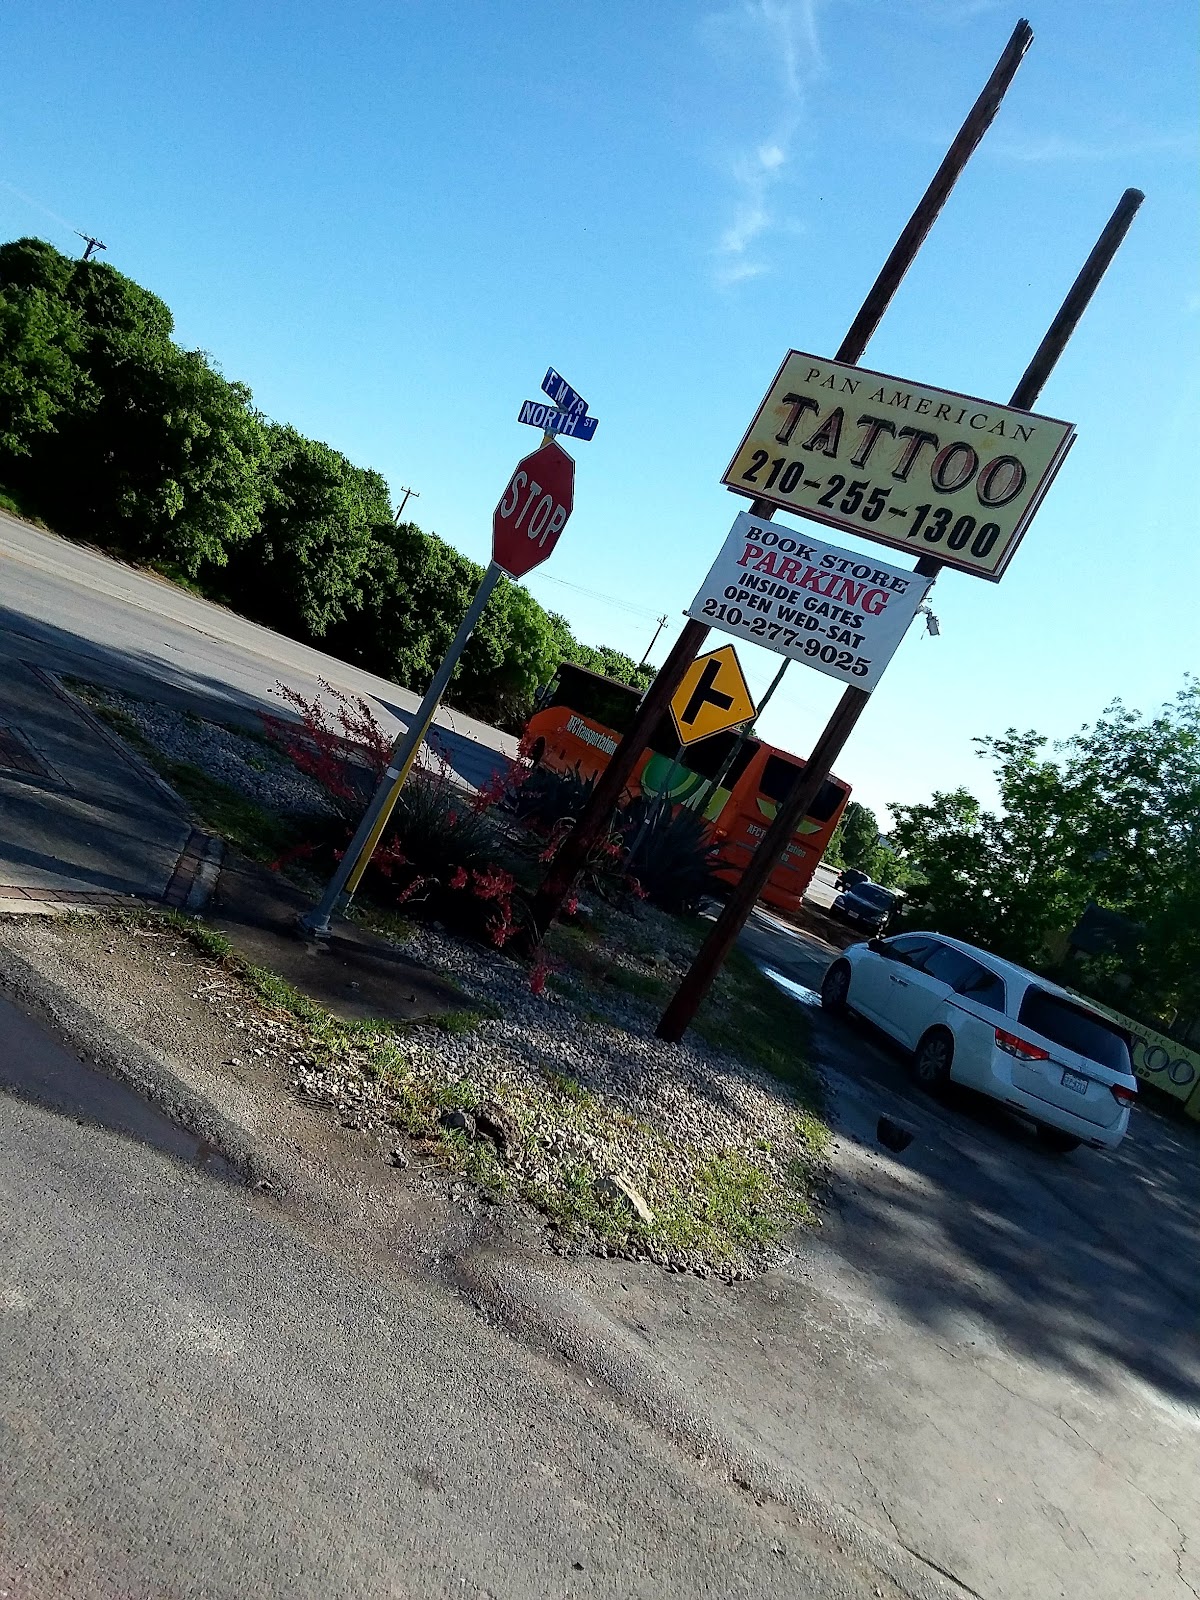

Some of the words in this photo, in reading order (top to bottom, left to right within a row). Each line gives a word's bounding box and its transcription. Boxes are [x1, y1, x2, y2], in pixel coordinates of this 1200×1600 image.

[520, 402, 580, 435] NORTH
[583, 418, 595, 428] ST
[803, 367, 862, 395] PAN
[869, 387, 1037, 443] AMERICAN
[774, 392, 1027, 509] TATTOO
[500, 470, 567, 548] STOP
[741, 449, 1001, 558] 210-255-1300
[736, 543, 891, 616] PARKING
[744, 526, 818, 562] BOOK
[819, 554, 911, 595] STORE
[701, 598, 872, 677] 210-277-9025
[723, 585, 773, 614] OPEN
[777, 604, 866, 650] WED-SAT
[738, 572, 801, 605] INSIDE
[803, 596, 866, 629] GATES
